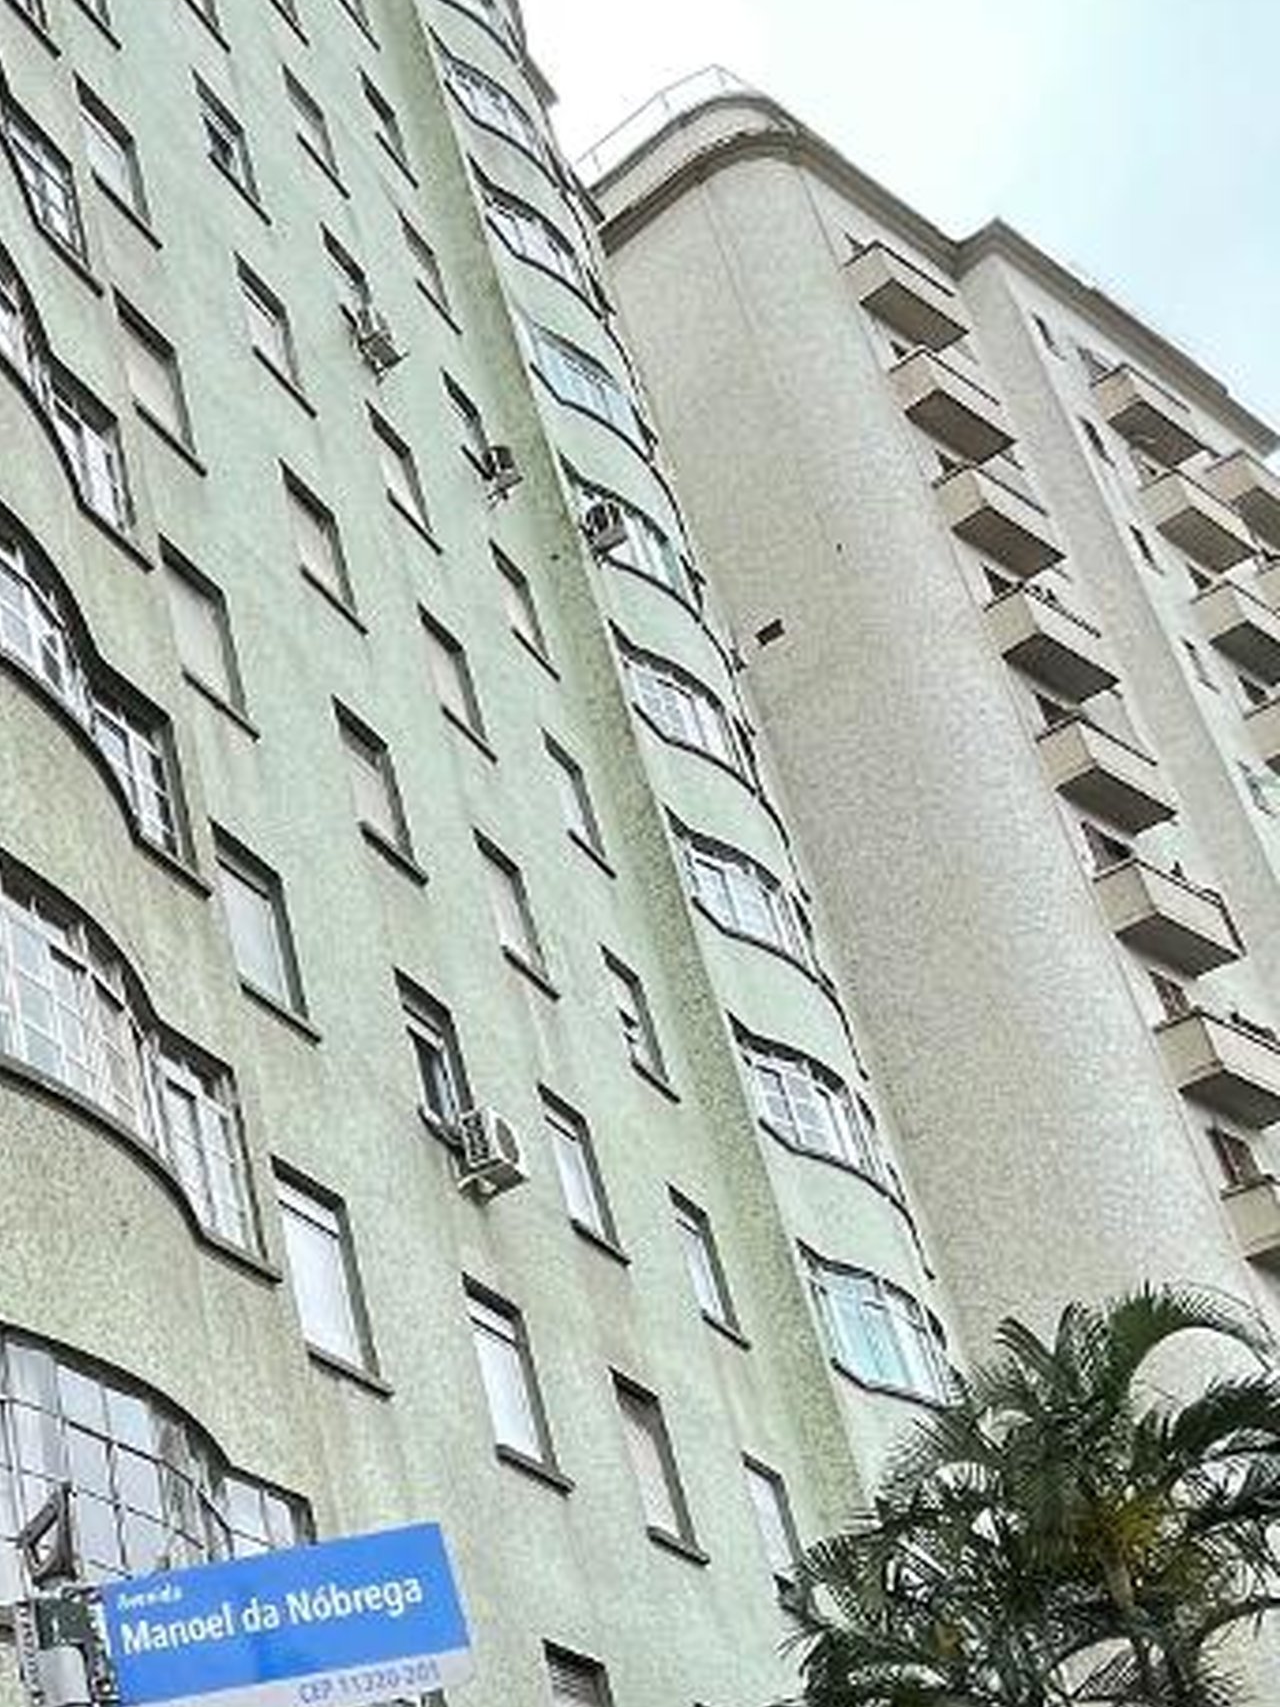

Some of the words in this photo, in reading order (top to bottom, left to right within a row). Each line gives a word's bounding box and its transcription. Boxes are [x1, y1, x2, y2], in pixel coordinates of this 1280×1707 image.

[120, 1601, 236, 1656] Manoel
[242, 1596, 280, 1634] da
[285, 1577, 423, 1625] Nóbrega
